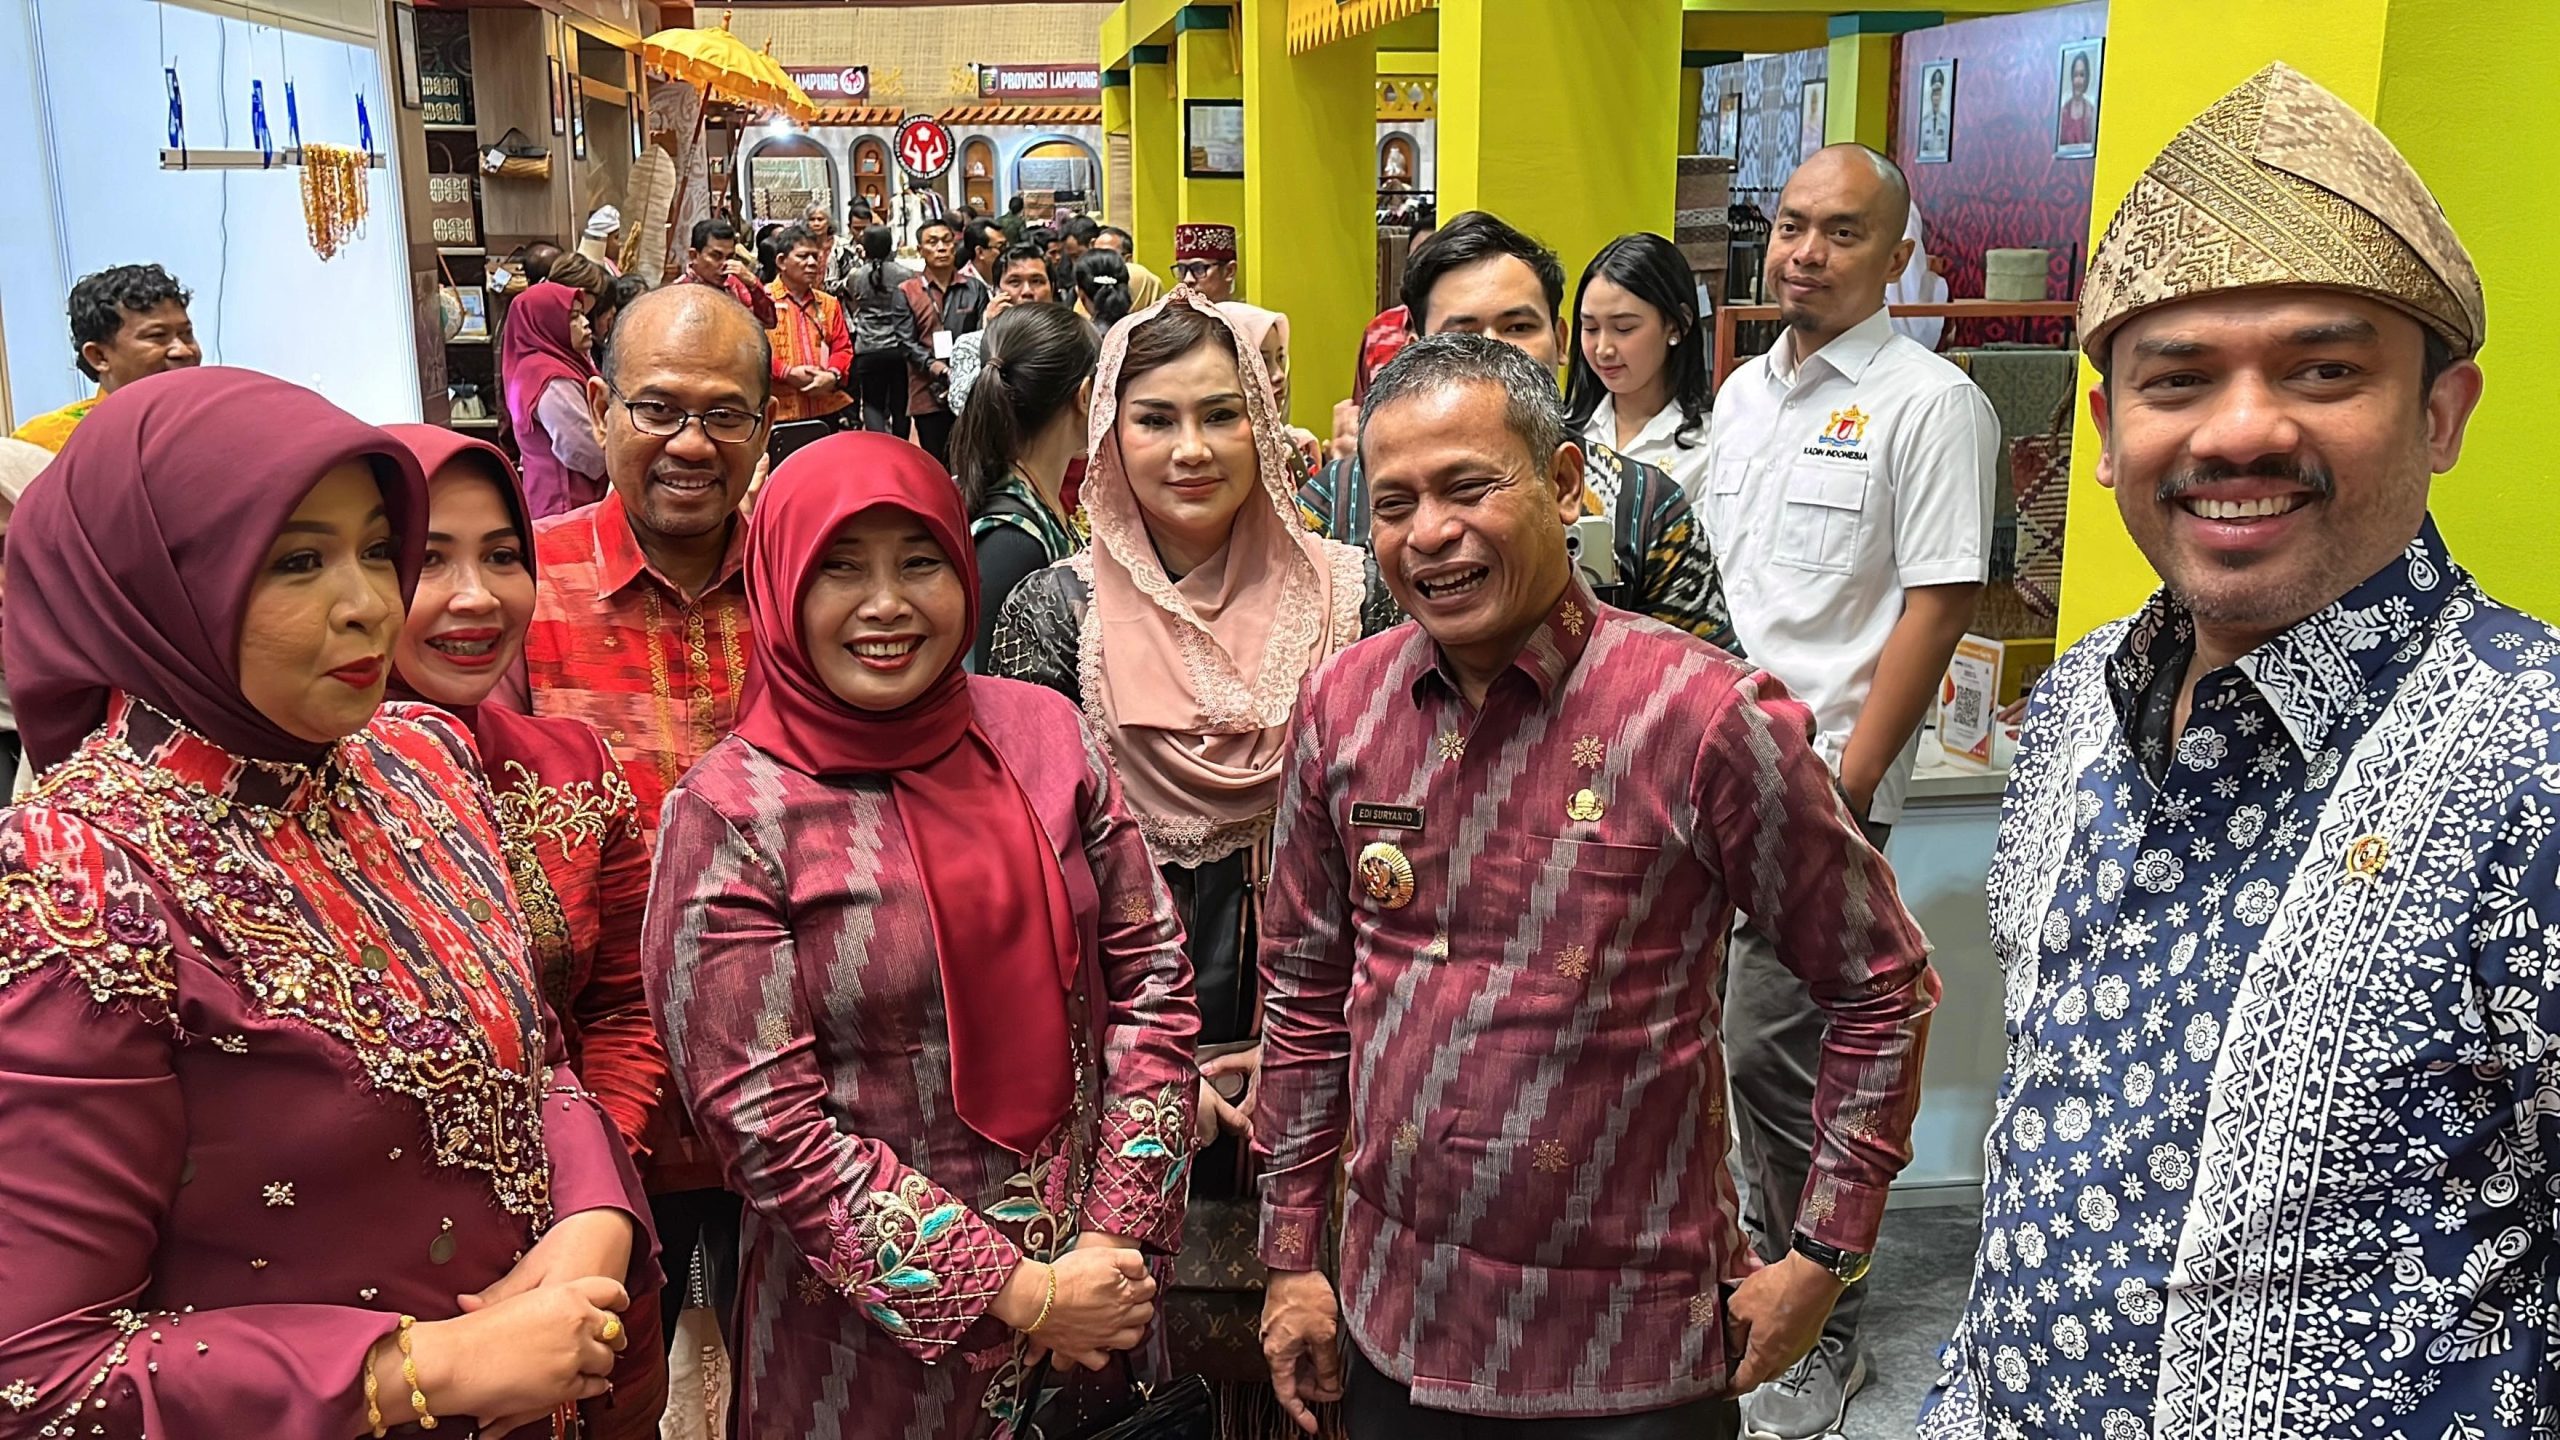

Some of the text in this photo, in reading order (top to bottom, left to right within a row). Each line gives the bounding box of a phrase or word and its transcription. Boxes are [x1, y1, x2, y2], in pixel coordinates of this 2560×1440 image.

[1000, 71, 1098, 90] PROVINSI LAMPUNG
[1825, 449, 1868, 461] INDONESIA
[1359, 808, 1412, 822] EDI SURYANTO
